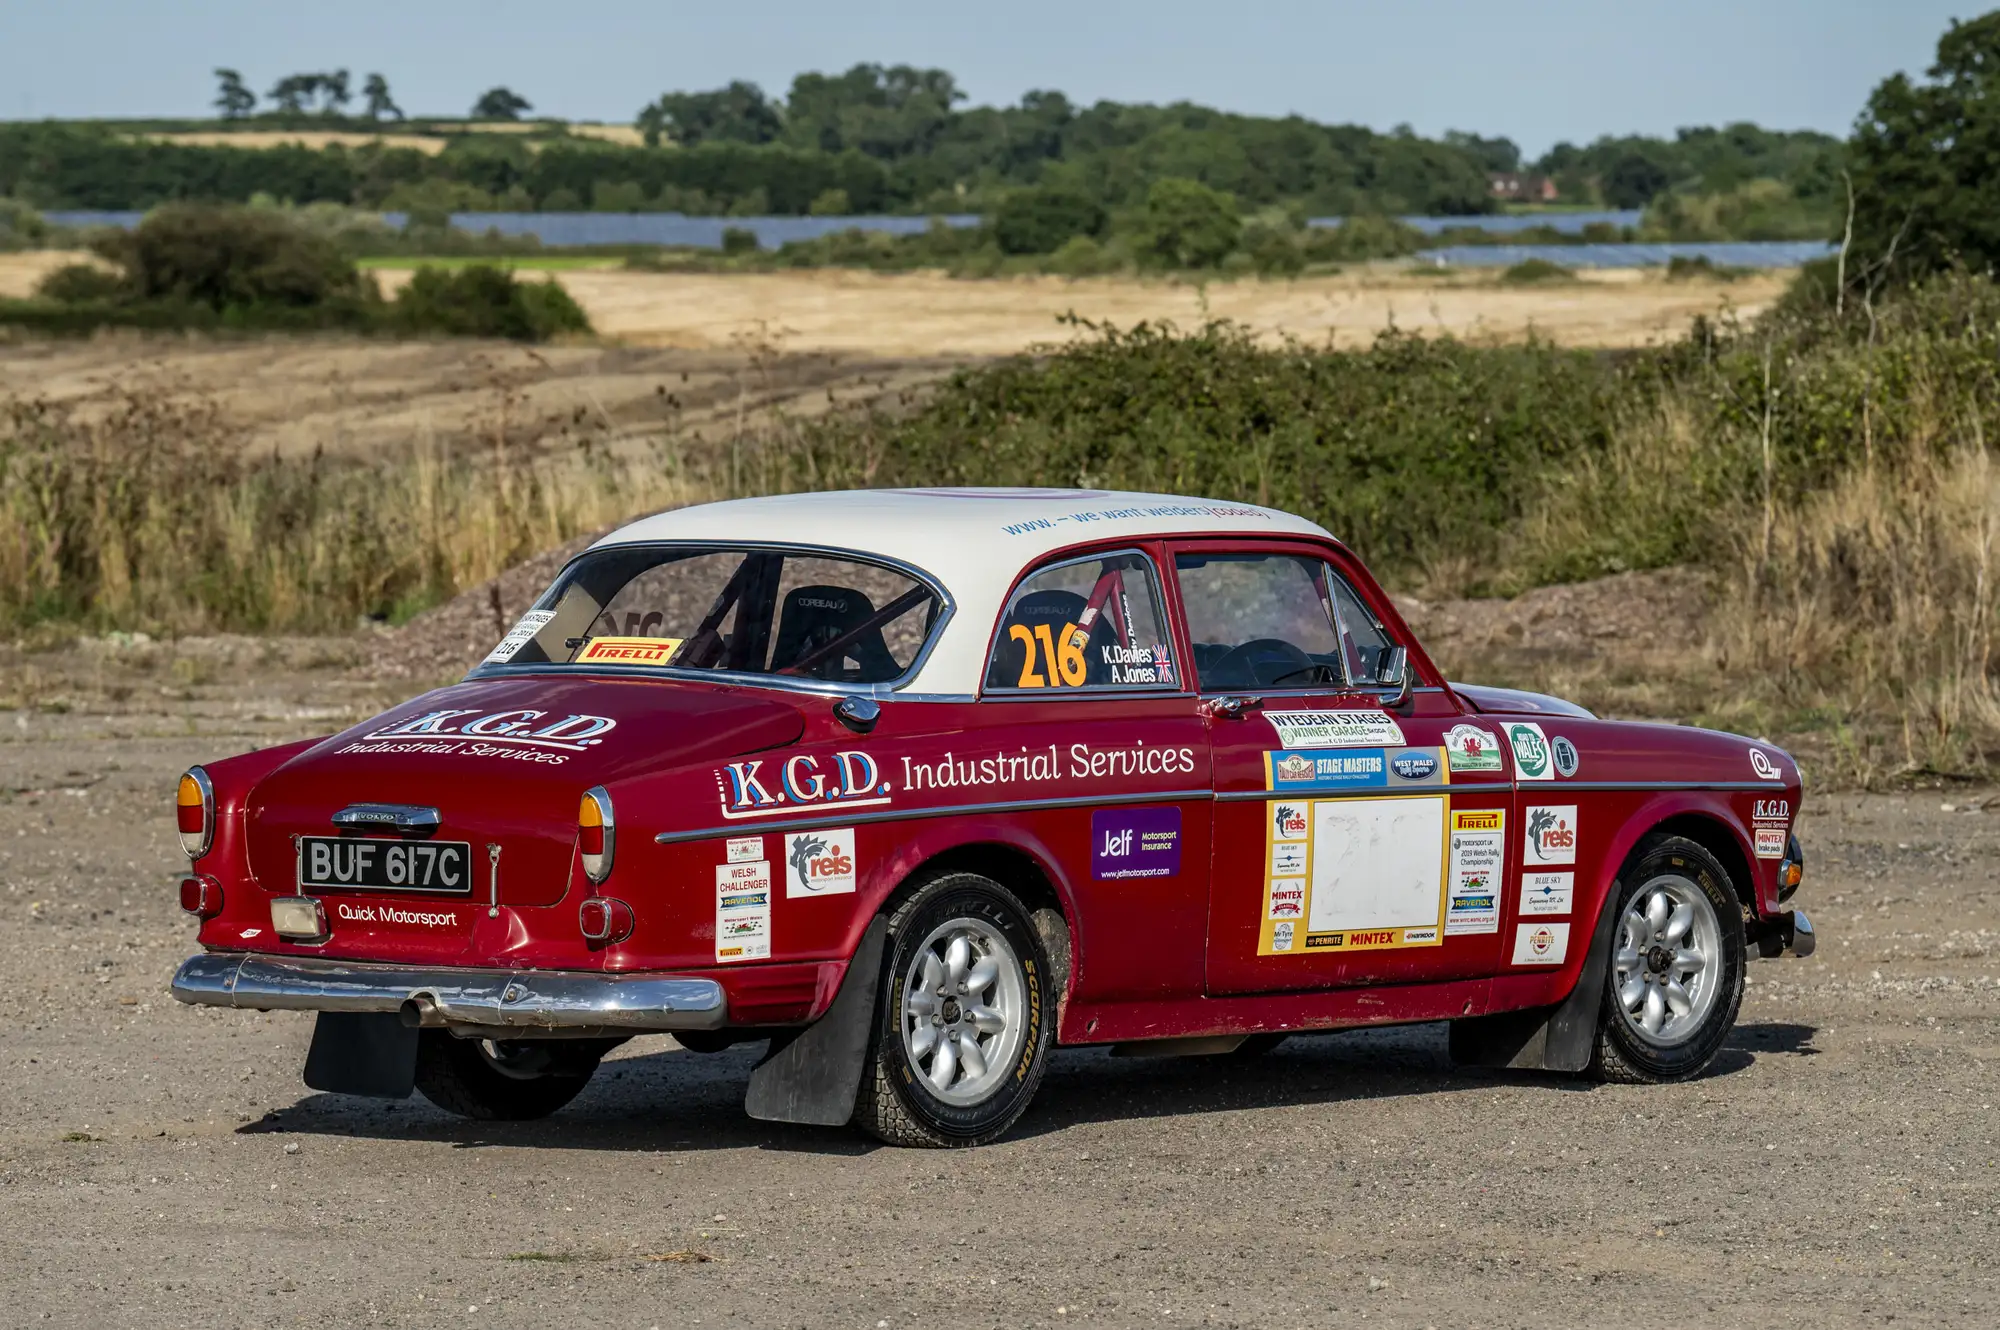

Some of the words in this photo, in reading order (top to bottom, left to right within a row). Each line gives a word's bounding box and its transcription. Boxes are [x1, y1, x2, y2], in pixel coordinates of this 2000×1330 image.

[1069, 511, 1100, 524] we
[1099, 506, 1145, 520] want
[1146, 504, 1210, 519] welders
[586, 642, 670, 659] PIRELLI
[1009, 621, 1087, 688] 216
[1102, 645, 1152, 664] K.Davies
[1111, 665, 1122, 683] A
[1123, 664, 1156, 683] Jones
[383, 709, 617, 746] K.G.D.
[1268, 713, 1340, 727] WYEDEAN
[1337, 713, 1391, 725] STAGES
[1290, 726, 1331, 738] WINNER
[1331, 725, 1369, 737] GARAGE
[334, 740, 459, 755] Industrial
[459, 741, 570, 765] Services
[1513, 739, 1546, 764] WALES
[901, 745, 1061, 791] Industrial
[1071, 740, 1194, 778] Services
[1317, 758, 1342, 774] STAGE
[1343, 757, 1382, 773] MASTERS
[1412, 759, 1433, 767] WALES
[724, 751, 891, 809] K.G.D.
[359, 812, 394, 821] VOLVO
[1756, 800, 1789, 817] K.G.D.
[1285, 812, 1306, 830] reis
[1458, 814, 1498, 828] PIRELLI
[1141, 830, 1177, 841] Motorsport
[1543, 819, 1574, 848] reis
[1100, 829, 1133, 857] Jelf
[1141, 841, 1172, 851] Insurance
[810, 844, 852, 877] reis
[1473, 849, 1488, 857] Welsh
[1489, 848, 1500, 857] Rally
[310, 842, 376, 882] BUF
[385, 845, 460, 886] 617C
[1461, 858, 1494, 867] Championship
[731, 867, 756, 879] WELSH
[1101, 867, 1170, 880] www.jelfmotorsport.com
[720, 879, 768, 893] CHALLENGER
[724, 896, 764, 906] RAVENOL
[1272, 891, 1303, 900] MINTEX
[1455, 899, 1491, 907] RAVENOL
[338, 904, 377, 921] Quick
[379, 906, 457, 928] Motorsport
[1315, 936, 1341, 945] PENRITE
[1350, 932, 1394, 945] MINTEX
[1530, 935, 1555, 945] PENRITE
[1016, 958, 1040, 1083] SCORPION
